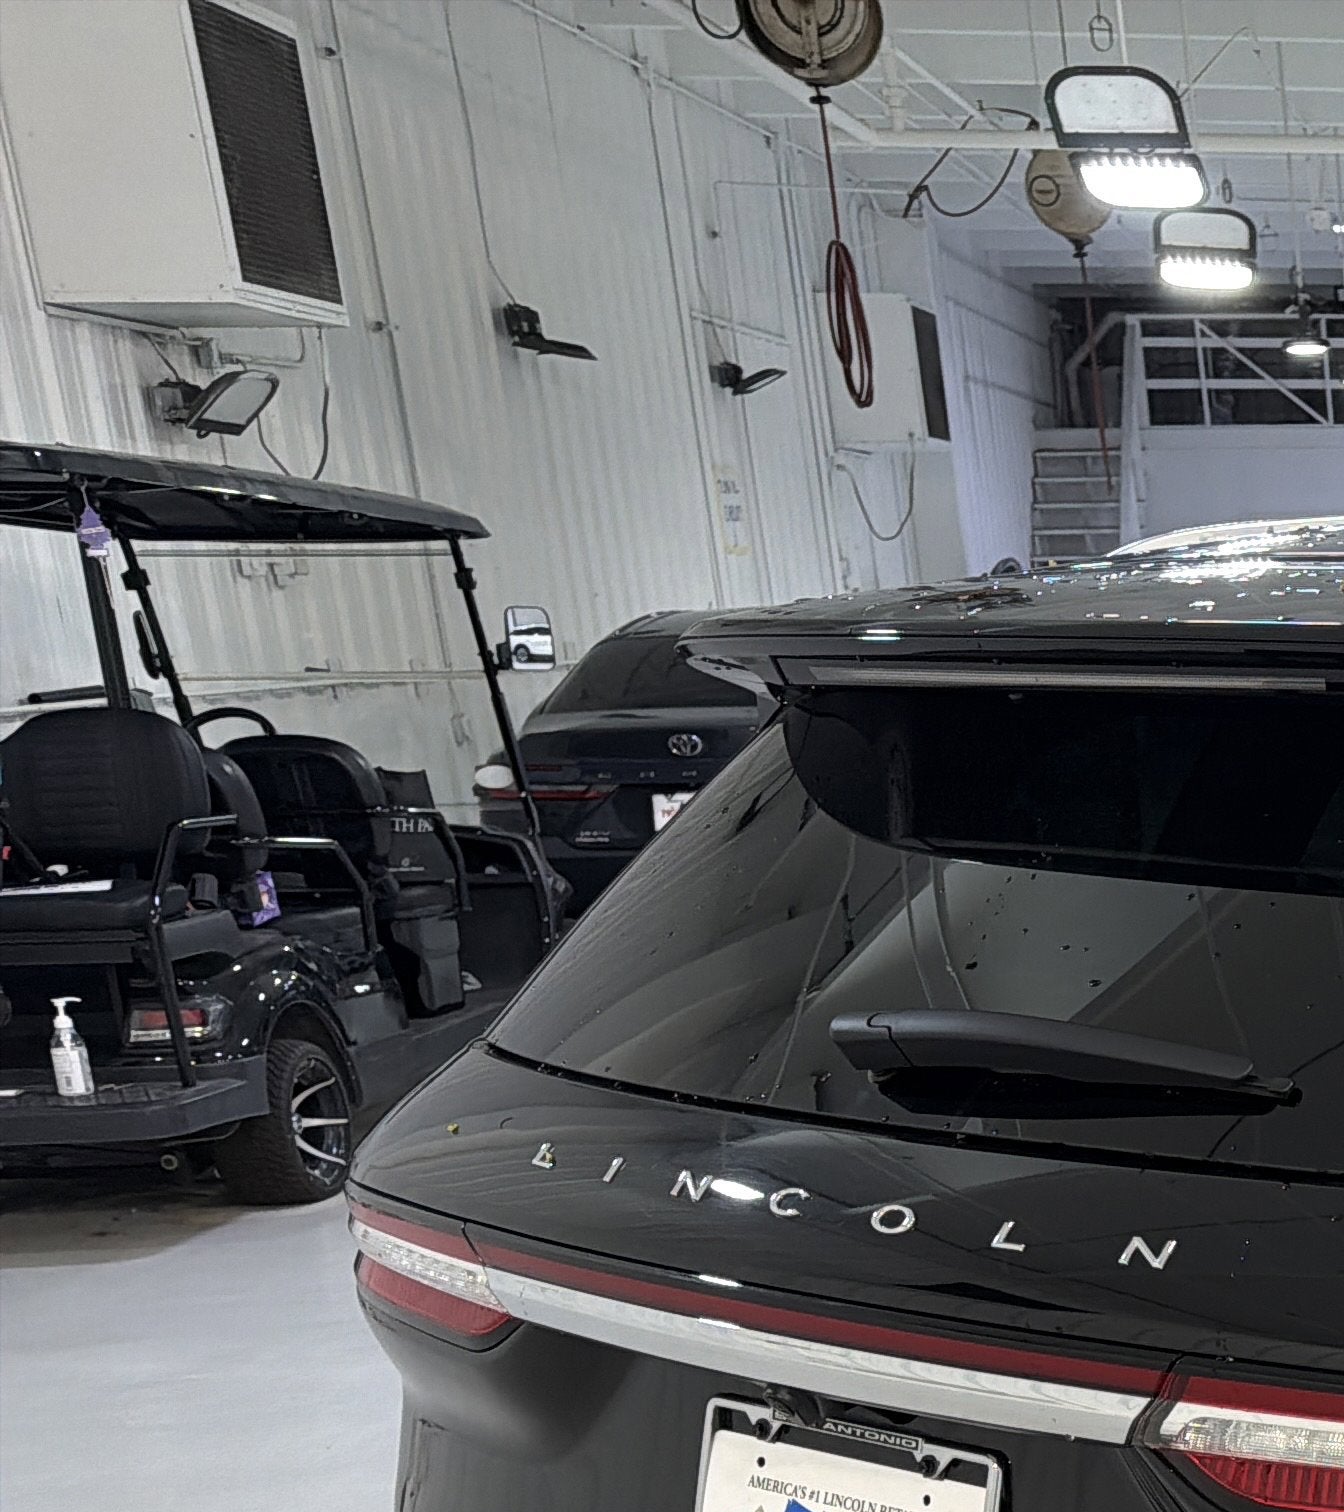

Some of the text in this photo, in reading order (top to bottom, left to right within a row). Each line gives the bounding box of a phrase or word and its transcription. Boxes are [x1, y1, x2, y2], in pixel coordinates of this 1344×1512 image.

[531, 1142, 1177, 1270] LINCOLN
[822, 1422, 917, 1448] ANTONIO
[747, 1474, 808, 1499] AMERICA'S
[808, 1489, 821, 1501] #1
